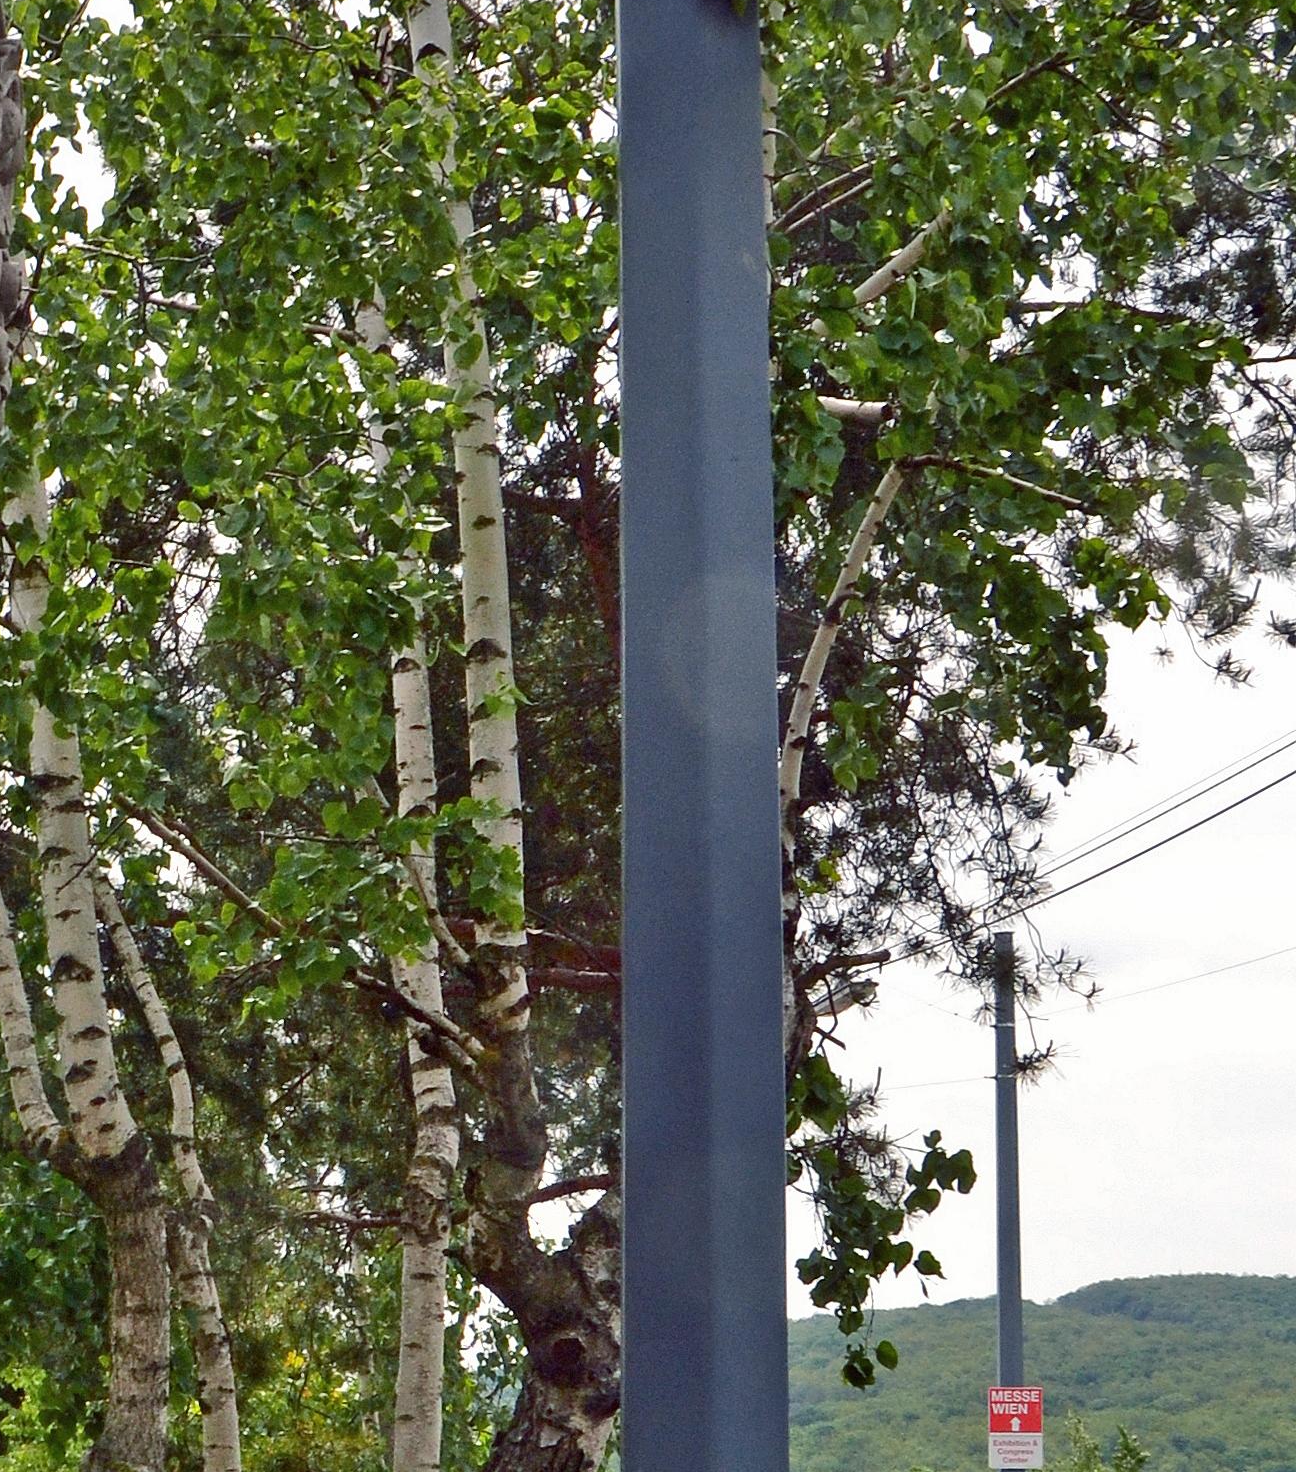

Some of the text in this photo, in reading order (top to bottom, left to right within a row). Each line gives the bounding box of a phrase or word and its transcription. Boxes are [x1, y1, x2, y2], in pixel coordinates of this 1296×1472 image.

[991, 1390, 1040, 1402] MESSE
[991, 1403, 1029, 1414] WIEN
[997, 1448, 1034, 1456] Congress
[1002, 1456, 1029, 1464] Center
